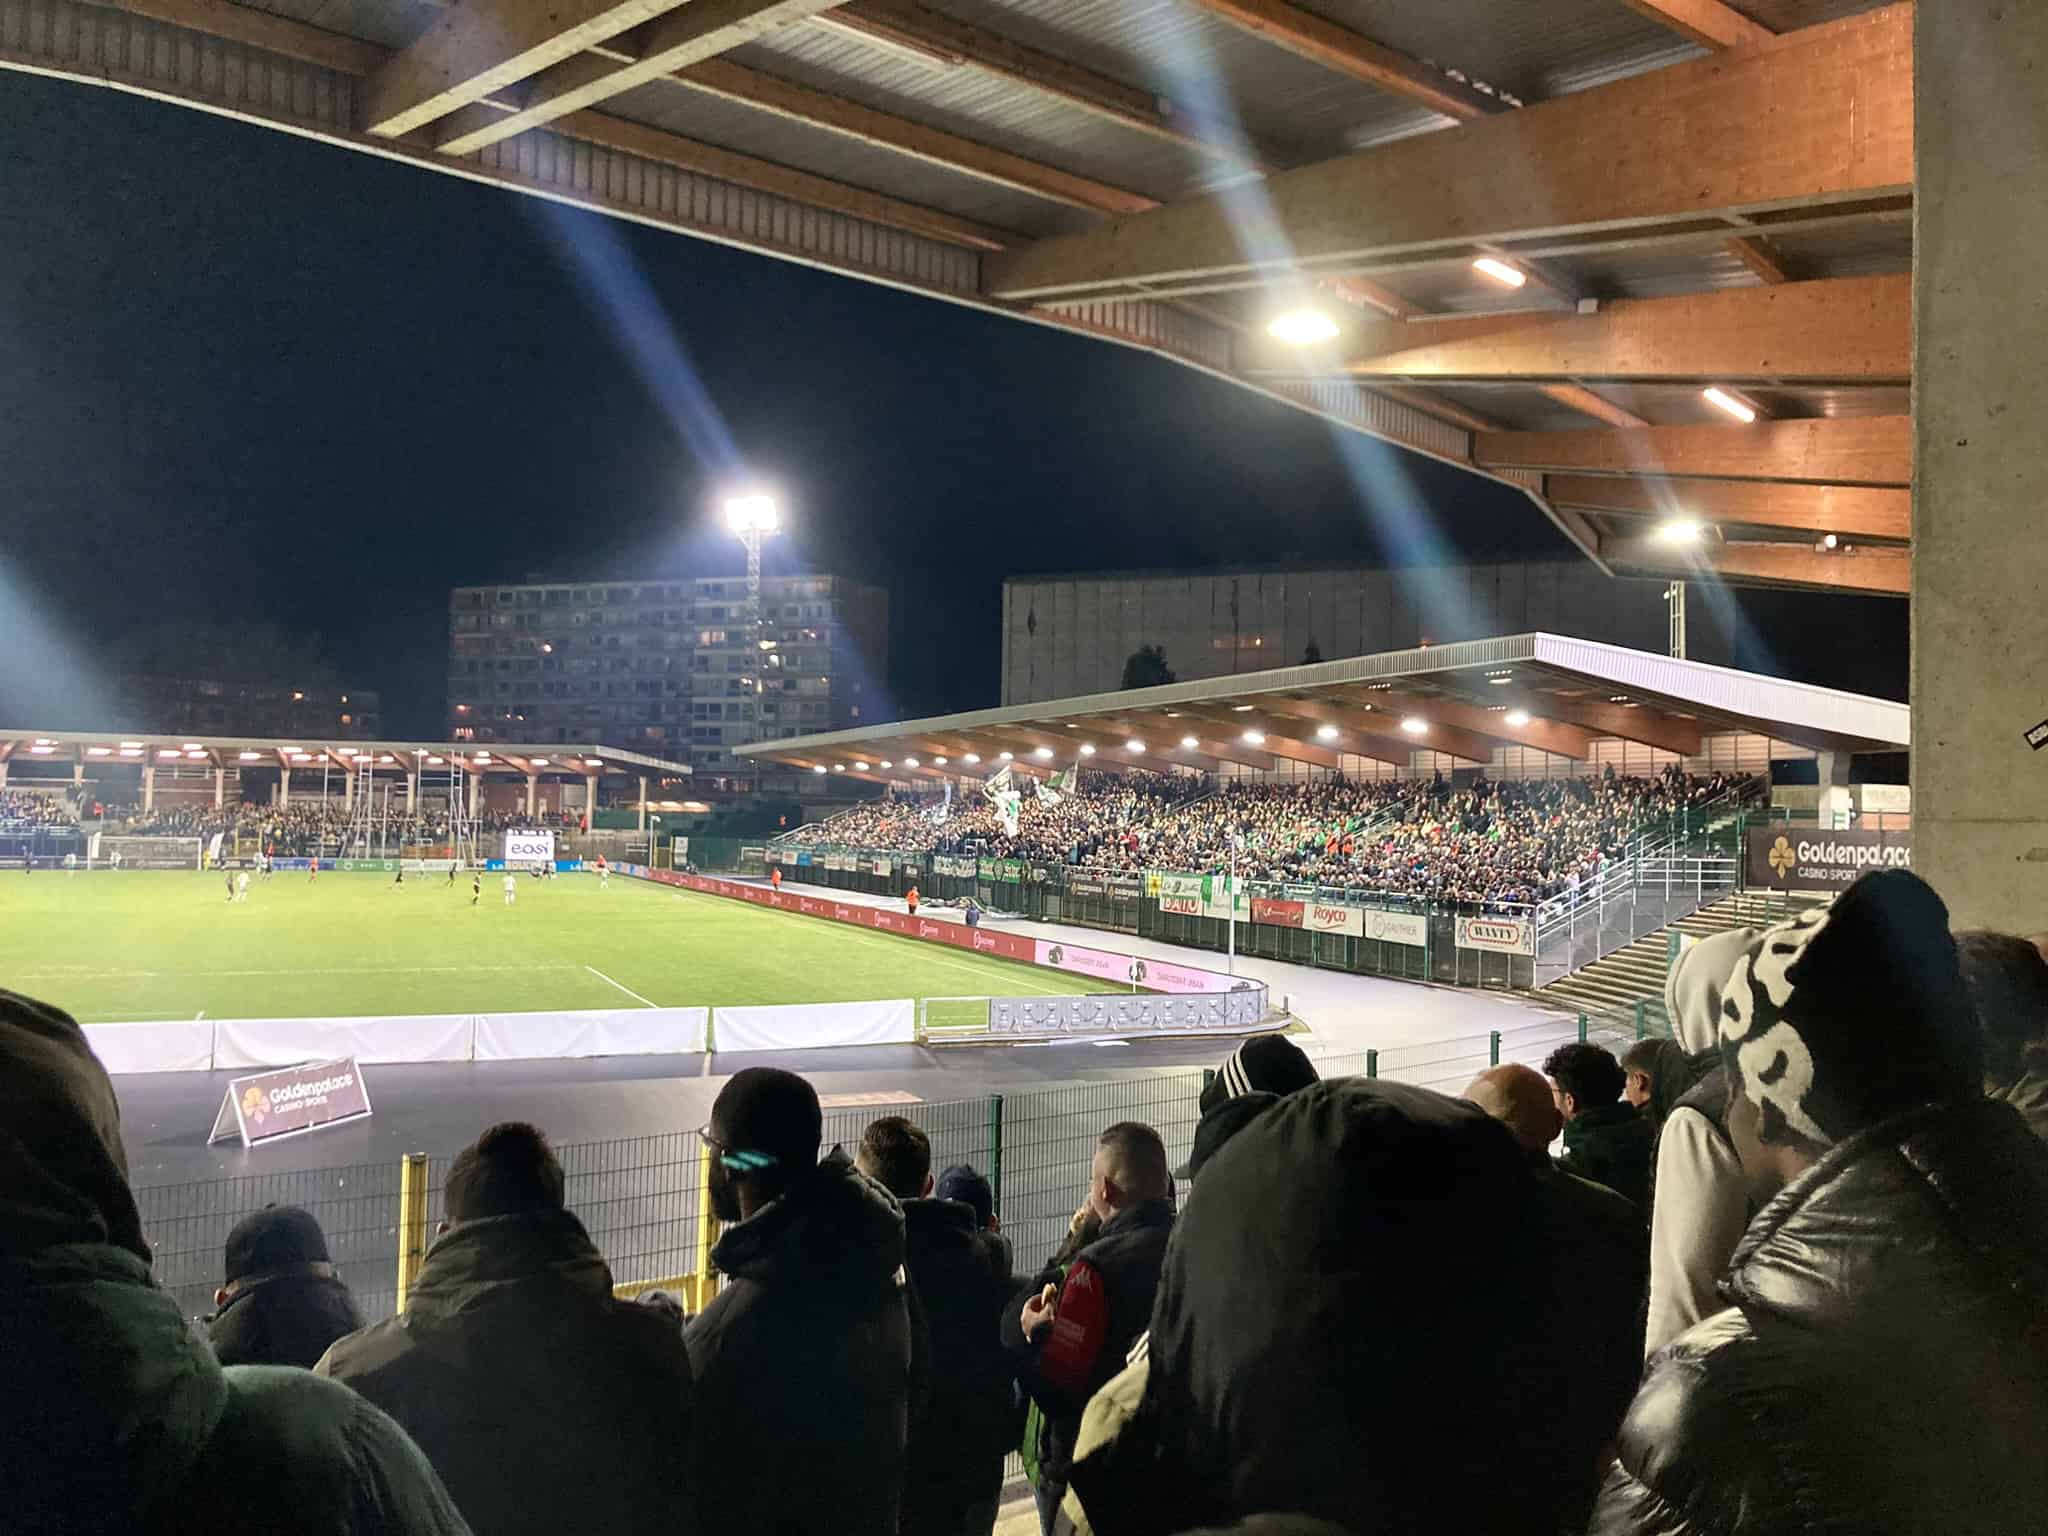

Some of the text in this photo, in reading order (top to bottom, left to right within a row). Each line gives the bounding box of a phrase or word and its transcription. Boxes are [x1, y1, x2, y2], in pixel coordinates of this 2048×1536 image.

[511, 841, 549, 854] easi
[1797, 866, 1828, 880] CASINO
[1313, 905, 1346, 924] Royco
[269, 1073, 354, 1104] Goldenpalace
